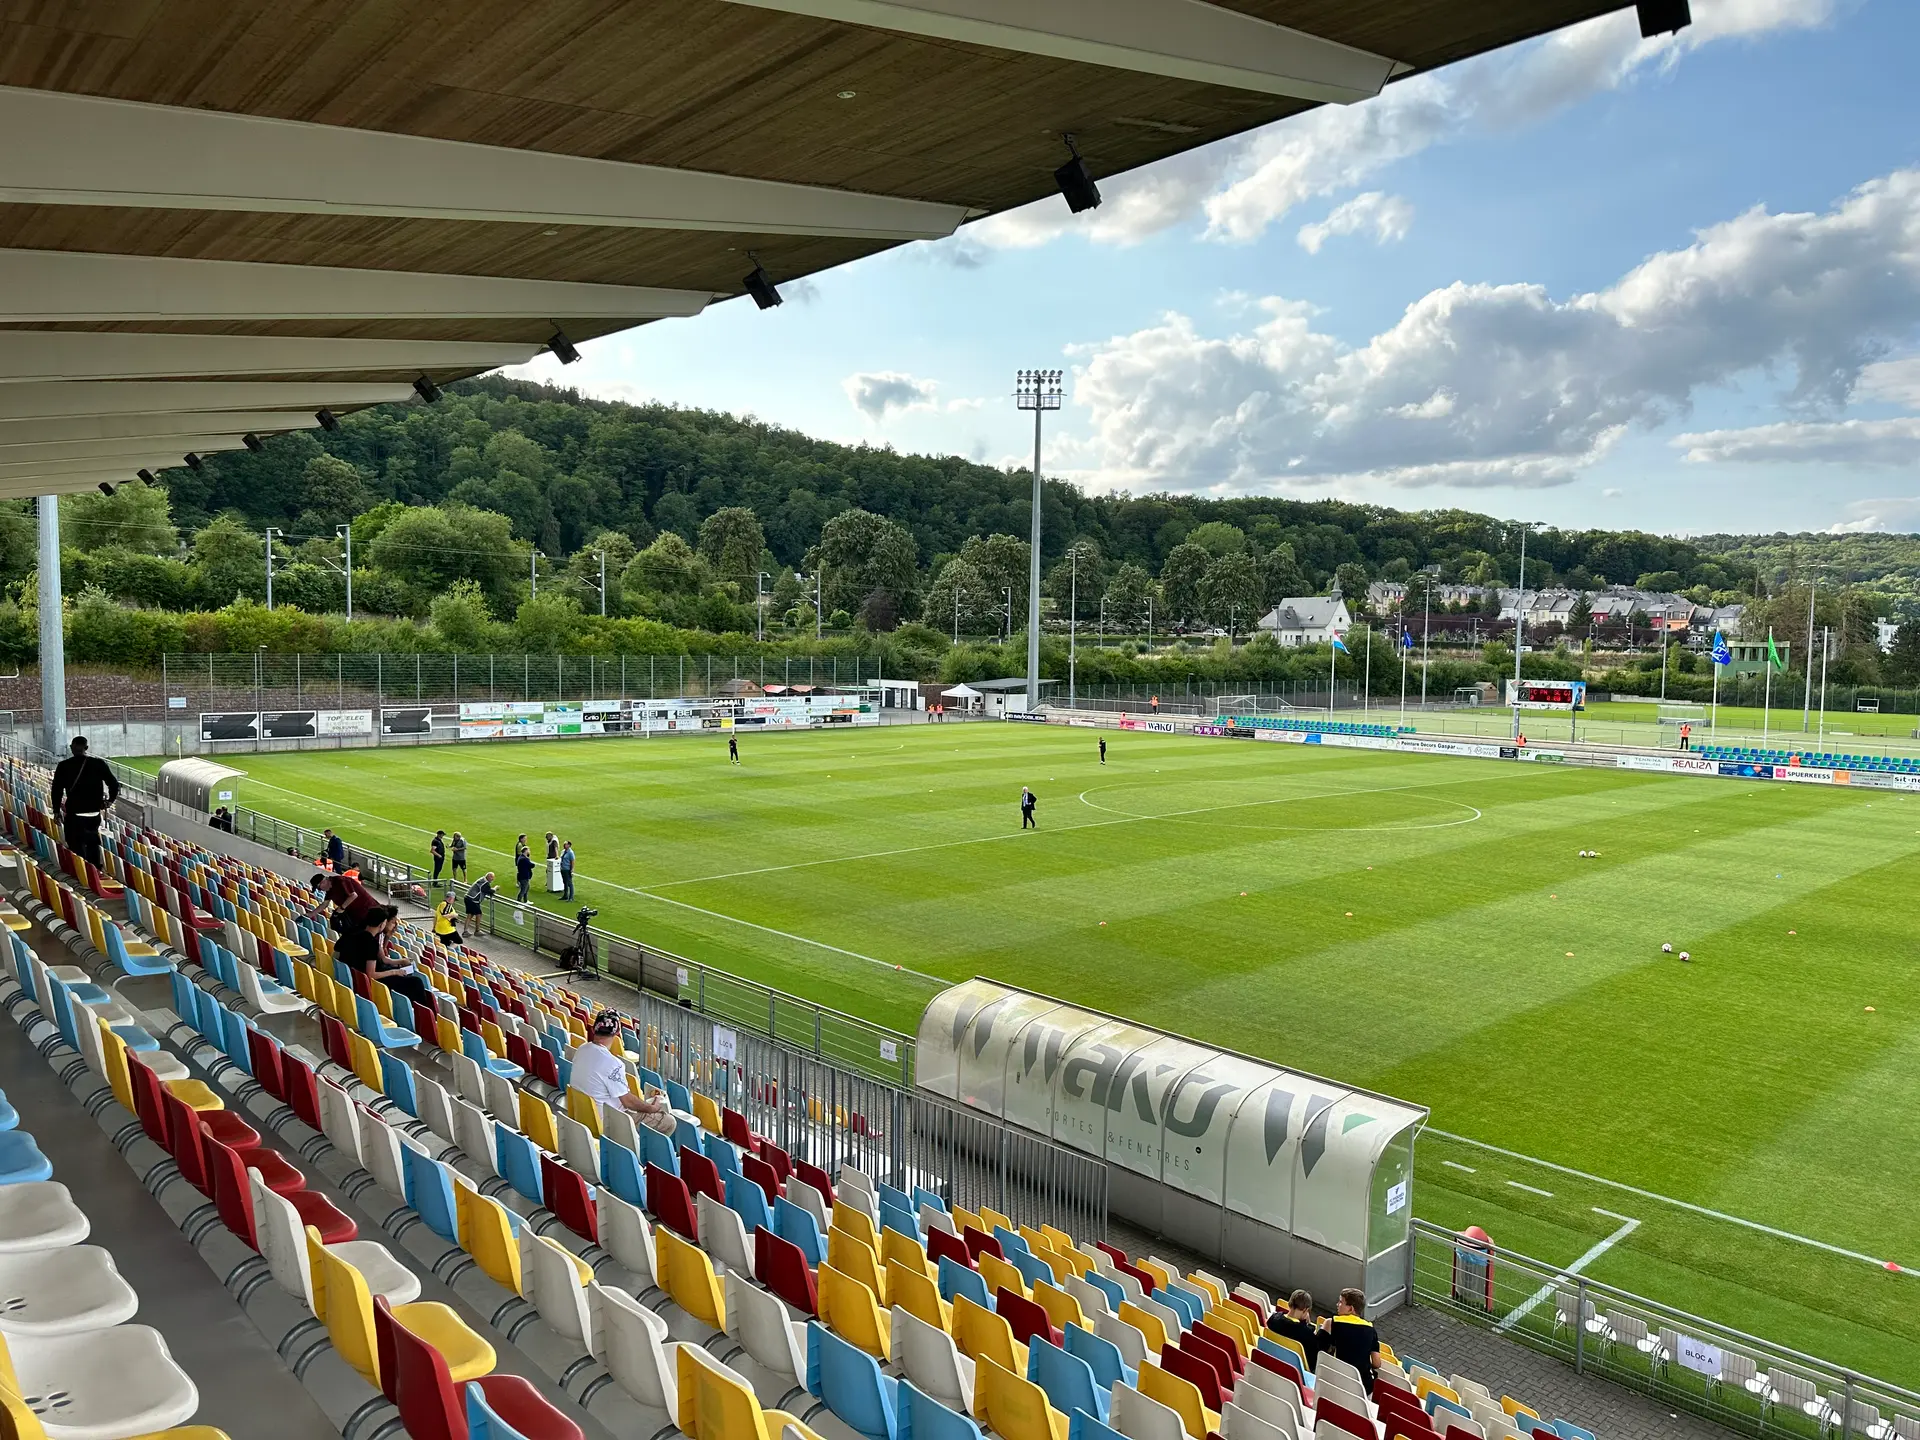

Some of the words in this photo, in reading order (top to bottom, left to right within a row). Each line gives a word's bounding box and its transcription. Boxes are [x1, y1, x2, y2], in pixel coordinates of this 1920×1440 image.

[1787, 770, 1831, 780] SPUERKEESS
[1045, 1107, 1093, 1135] PORTES
[1685, 1349, 1706, 1362] BLOC
[1707, 1357, 1714, 1365] A
